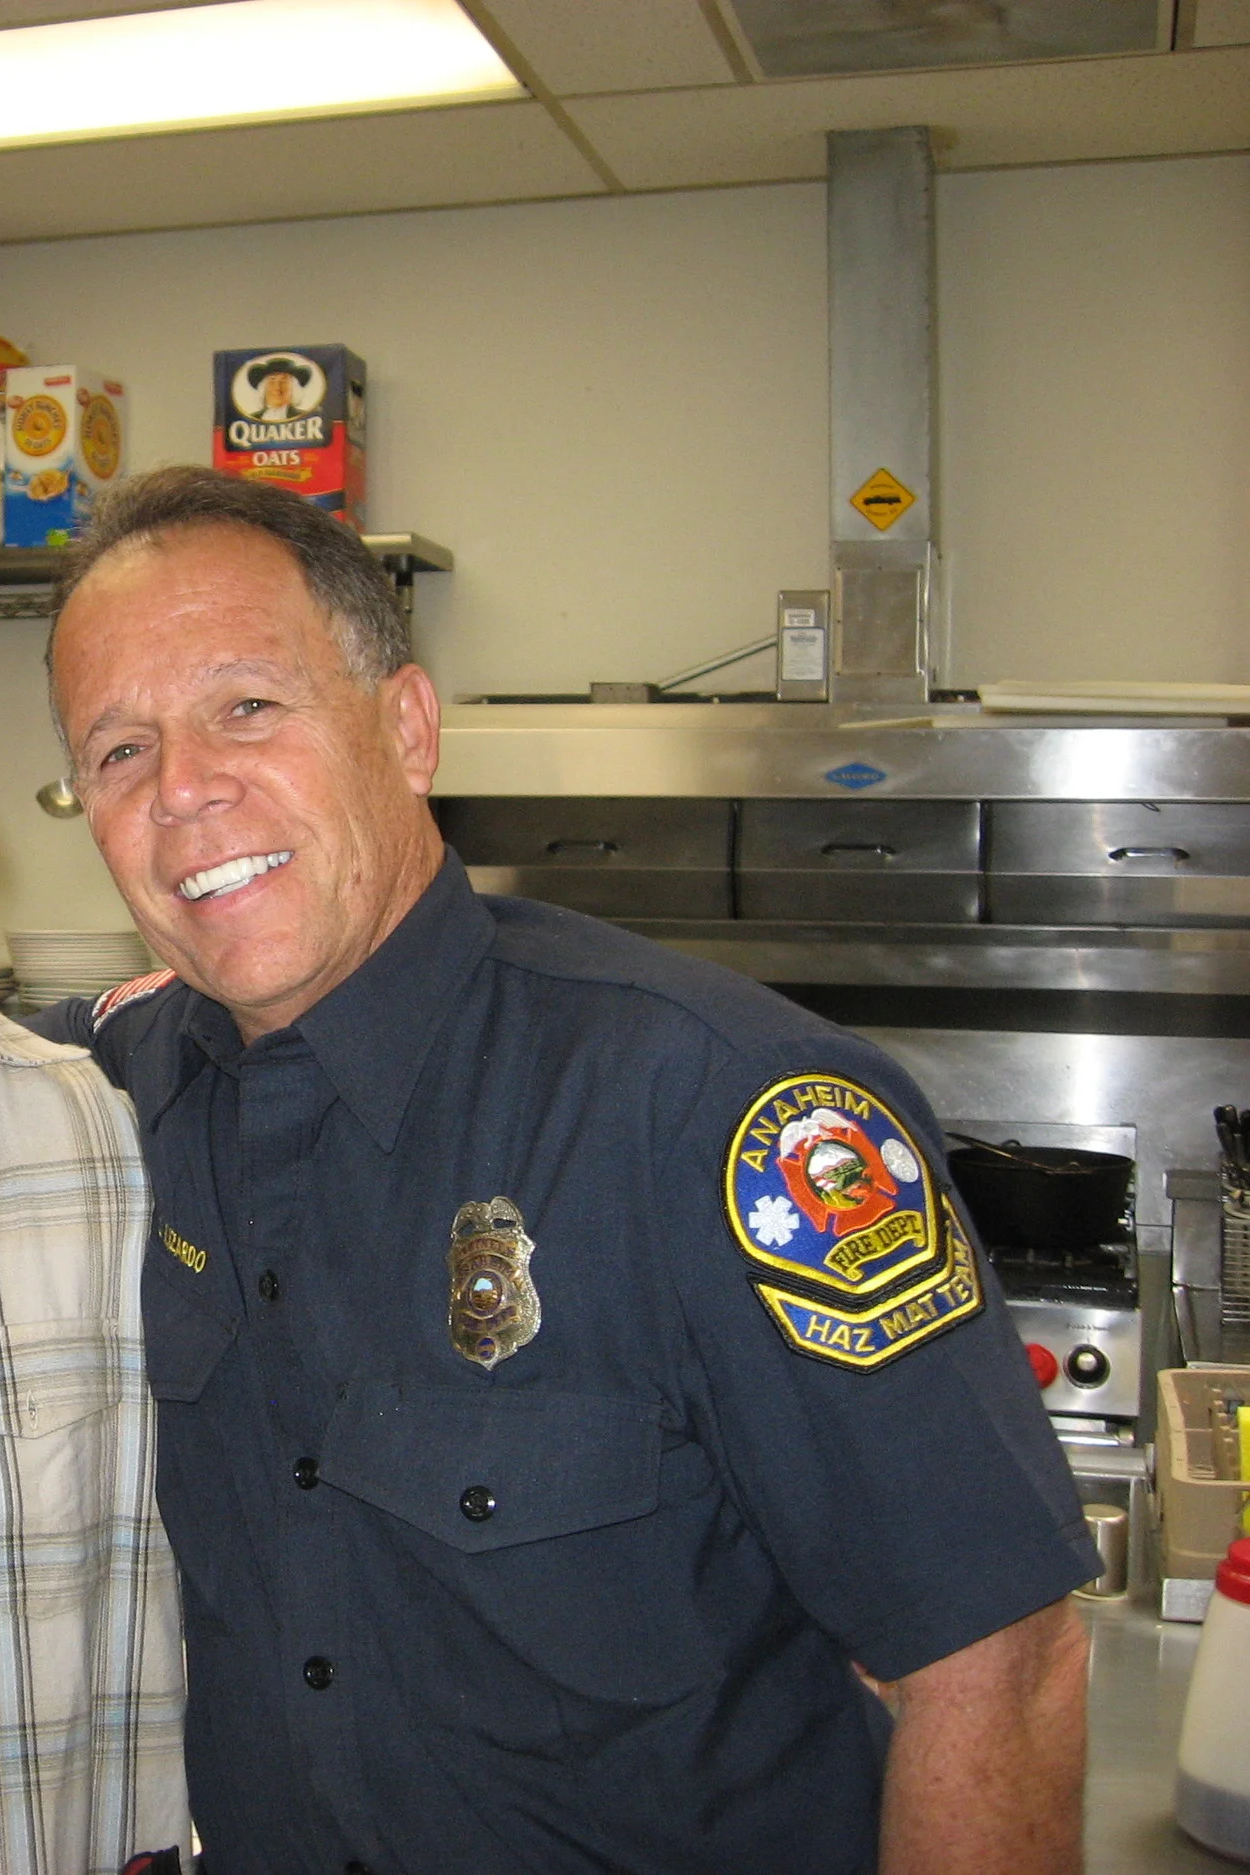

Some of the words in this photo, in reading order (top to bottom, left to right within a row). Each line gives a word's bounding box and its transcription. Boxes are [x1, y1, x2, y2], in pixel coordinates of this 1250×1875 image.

[229, 416, 324, 448] QUAKER
[253, 450, 300, 466] OATS
[742, 1085, 872, 1172] ANAHEIM
[830, 1234, 879, 1272] FIRE
[875, 1214, 922, 1249] DEPT
[805, 1314, 876, 1353] HAZ
[879, 1294, 938, 1340] MAT
